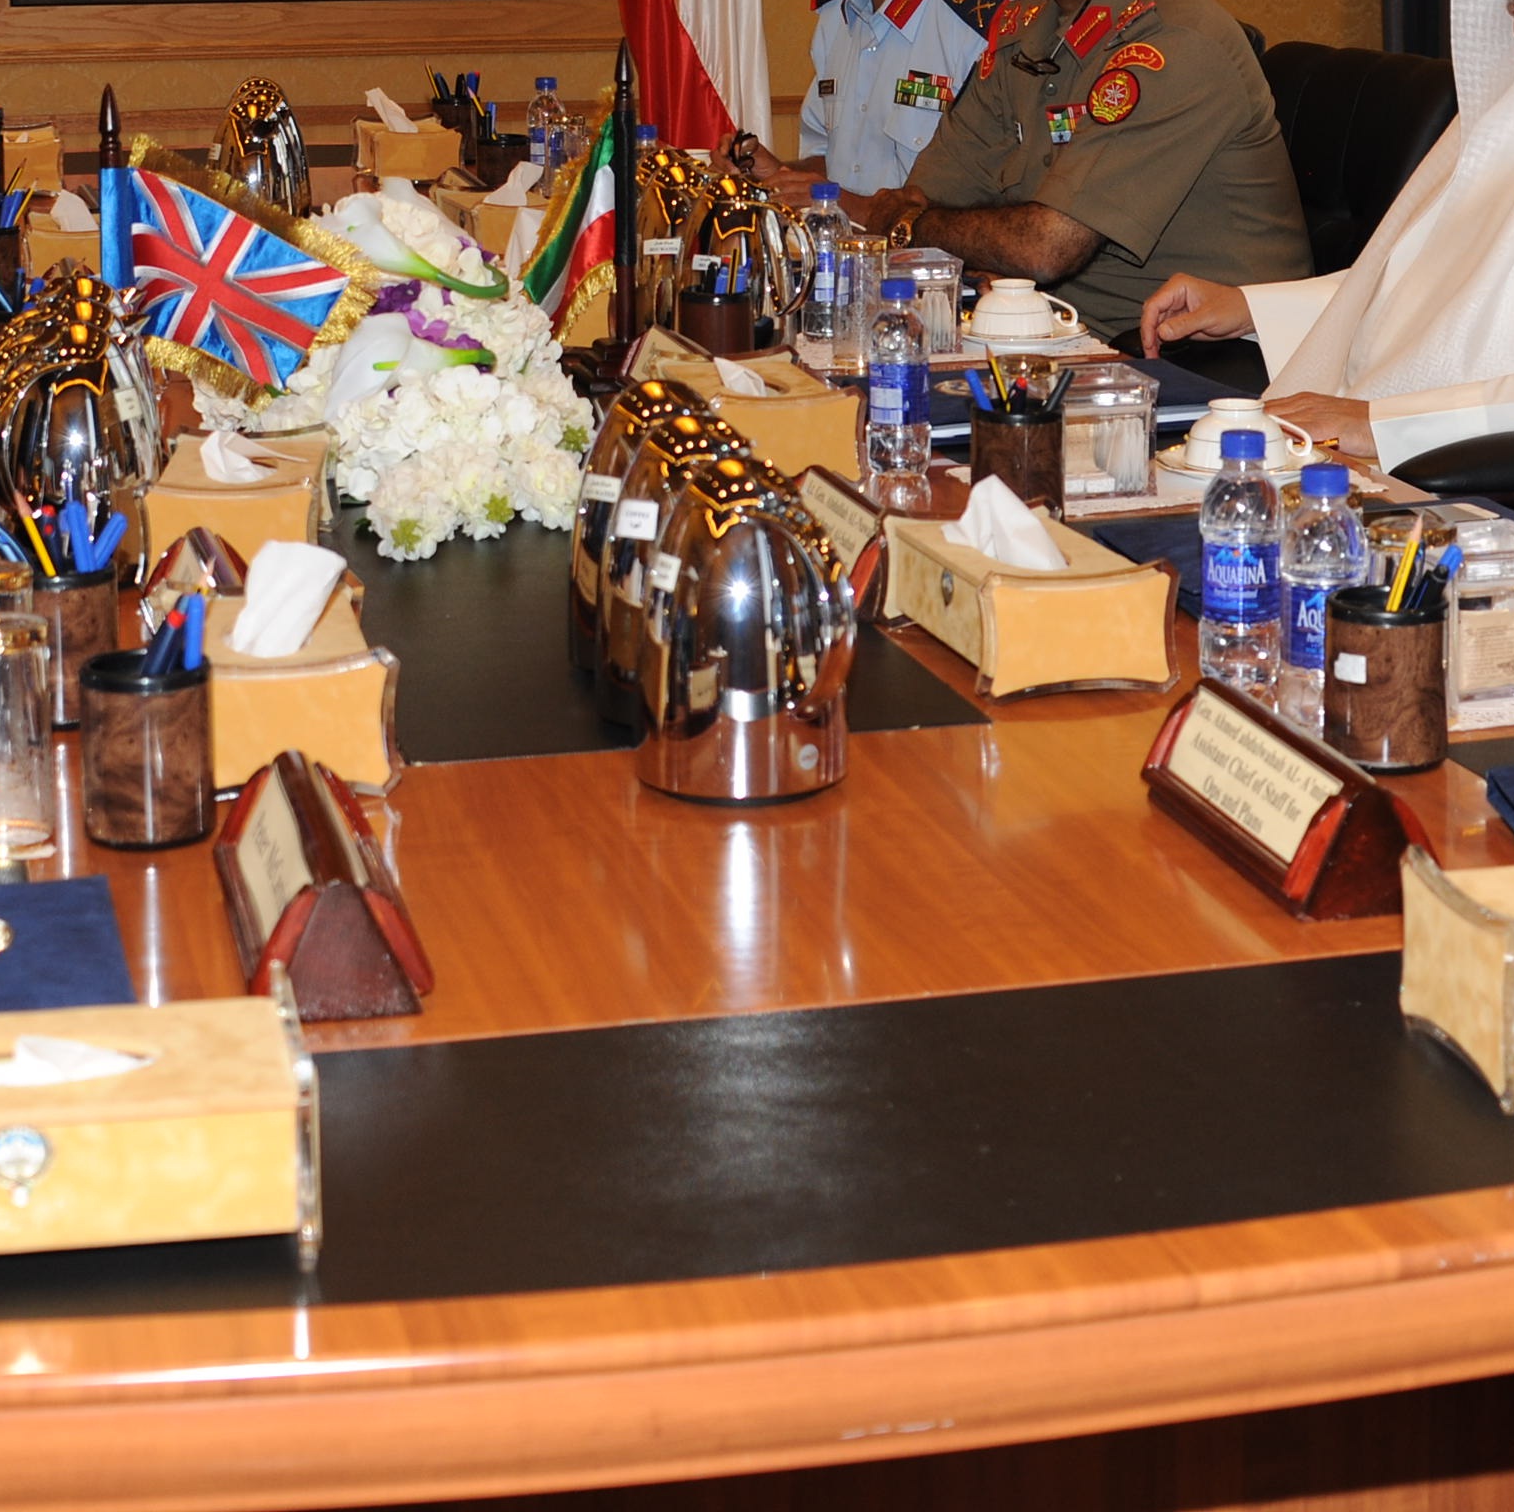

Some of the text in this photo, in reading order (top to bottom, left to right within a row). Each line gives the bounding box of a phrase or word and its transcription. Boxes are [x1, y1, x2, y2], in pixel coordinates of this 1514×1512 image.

[1192, 732, 1301, 822] Assistant Chief of Staff for
[1203, 775, 1263, 833] Ops and Plans
